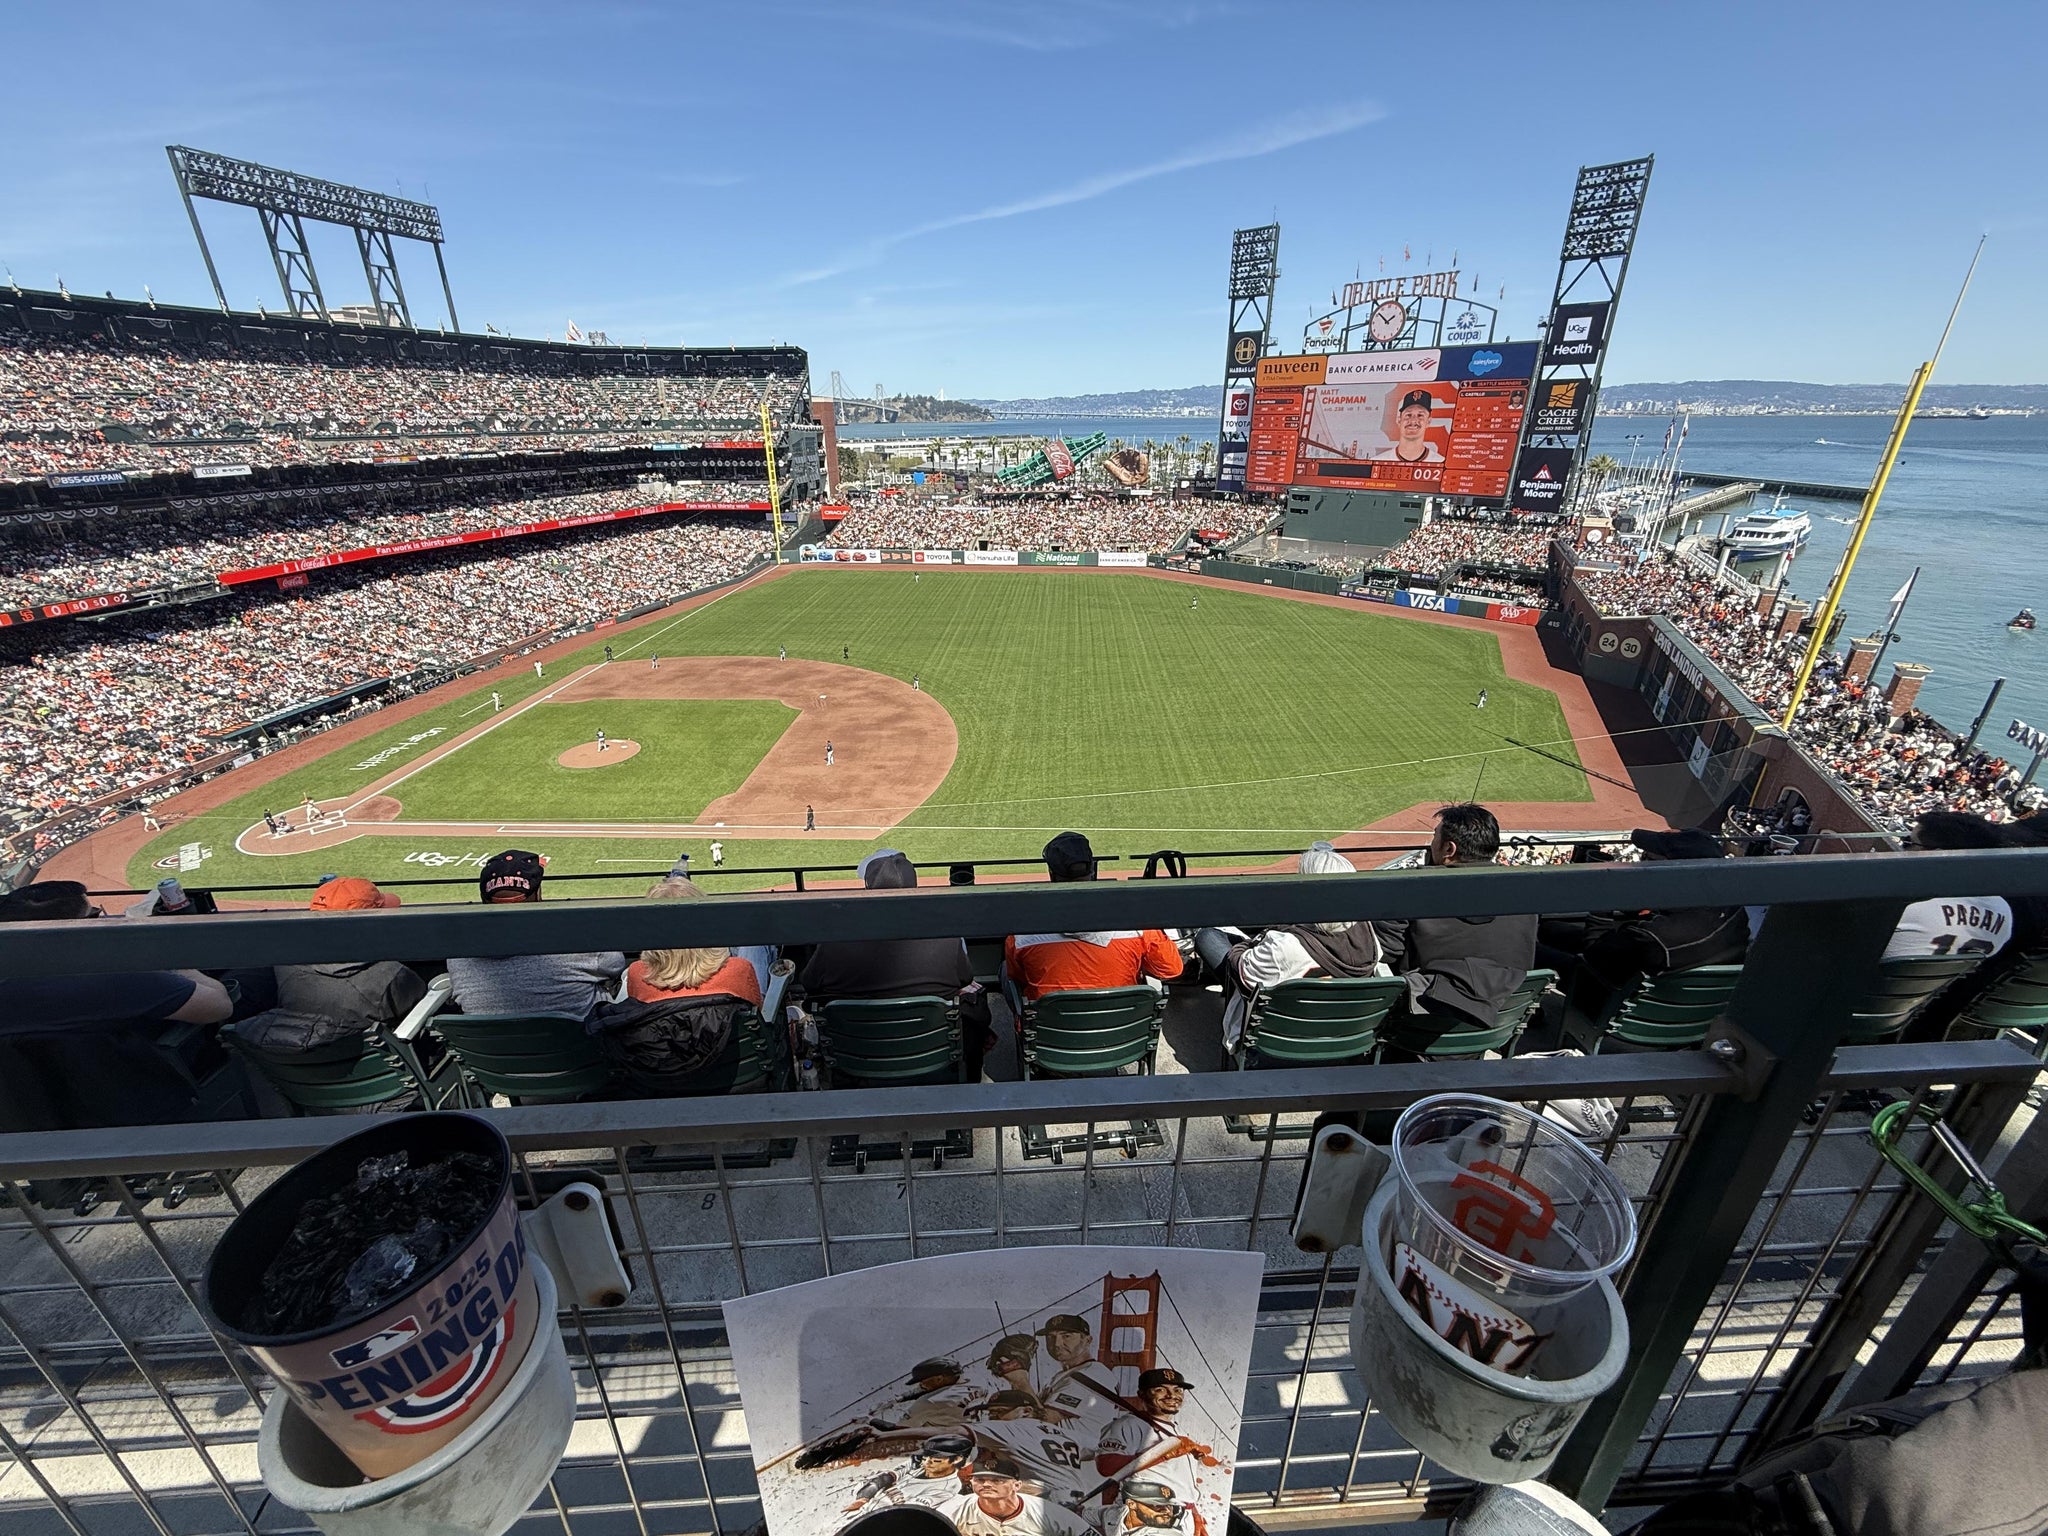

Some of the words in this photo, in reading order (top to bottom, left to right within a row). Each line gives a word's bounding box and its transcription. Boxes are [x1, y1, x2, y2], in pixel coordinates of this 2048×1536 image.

[1342, 277, 1406, 309] ORACLE
[1412, 270, 1461, 299] PARK
[1304, 336, 1342, 348] Fanatics
[1448, 330, 1479, 342] coupa
[1553, 344, 1592, 356] Health
[1263, 362, 1319, 374] nuveen
[1328, 365, 1353, 374] BANK
[1355, 365, 1366, 373] OF
[1370, 363, 1413, 373] AMERICA
[1322, 396, 1366, 404] CHAPMAN
[1538, 408, 1578, 417] CACHE
[1225, 420, 1251, 428] TOYOTA
[1537, 417, 1574, 425] CREEK
[883, 472, 912, 484] blue
[1519, 480, 1562, 490] Benjamin
[1523, 490, 1554, 498] Moore
[588, 515, 603, 523] thirsty
[376, 547, 392, 555] Fan
[392, 544, 413, 552] work
[421, 540, 446, 549] thirsty
[446, 536, 464, 544] work
[1046, 554, 1080, 562] National
[1453, 587, 1483, 596] WELCOME
[1408, 593, 1445, 611] VISA
[1602, 637, 1616, 648] 24
[1624, 643, 1637, 653] 30
[1670, 646, 1703, 691] LANDING
[404, 852, 460, 866] UCSF
[1941, 904, 2005, 935] PAGAN
[701, 1193, 716, 1210] 8
[426, 1249, 491, 1325] 2025
[1040, 1438, 1081, 1470] 62
